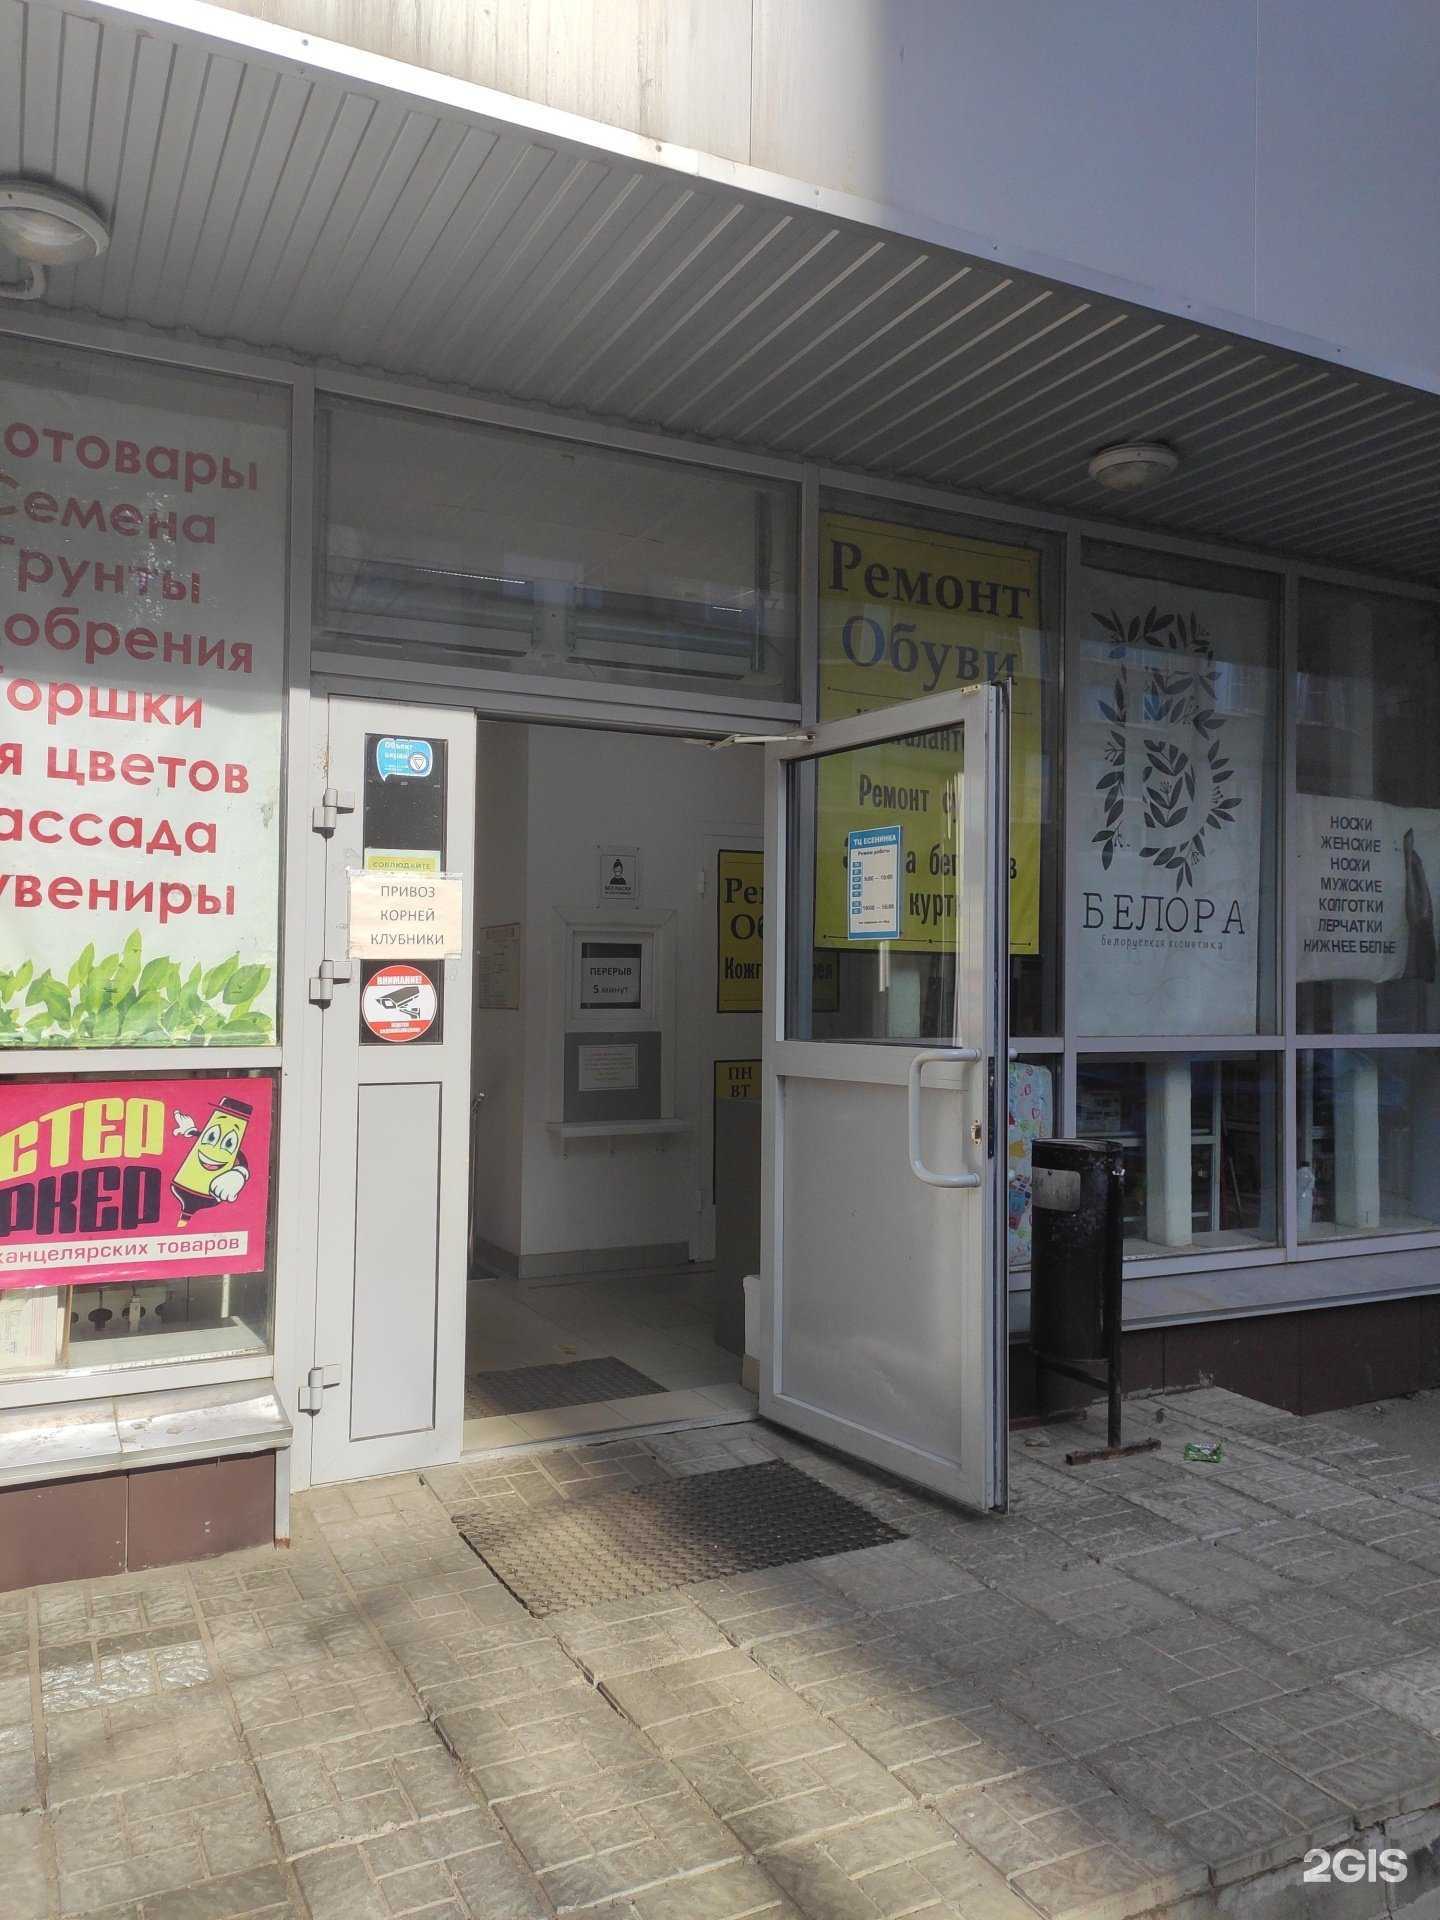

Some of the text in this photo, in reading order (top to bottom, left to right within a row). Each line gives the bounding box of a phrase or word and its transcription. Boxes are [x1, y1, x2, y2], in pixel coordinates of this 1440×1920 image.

[4, 422, 258, 492] отовары
[828, 539, 1030, 619] Ремонт
[0, 607, 254, 674] обрения
[842, 616, 1018, 692] Обуви
[6, 678, 203, 729] оршки
[47, 746, 249, 794] цветов
[859, 773, 930, 813] Ремонт
[1330, 816, 1372, 831] НОСКИ
[0, 808, 217, 856] ассада
[1320, 836, 1381, 852] ЖЕНСКИЕ
[1330, 857, 1370, 872] НОСКИ
[381, 885, 435, 898] ПРИВОЗ
[724, 877, 763, 905] Ре
[1320, 877, 1383, 893] МУЖСКИЕ
[909, 889, 957, 924] курт
[1083, 892, 1245, 935] БЕЛОРА
[1318, 898, 1384, 913] КОЛГОТКИ
[380, 908, 435, 921] КОРНЕЙ
[1318, 918, 1383, 933] ПЕРЧАТКИ
[370, 933, 444, 945] КЛУБНИКИ
[1303, 939, 1357, 953] НИЖНЕЕ
[590, 967, 633, 977] ПЕРЕРЫВ
[593, 984, 600, 994] 5
[728, 1066, 752, 1081] ПН
[731, 1084, 751, 1098] ВТ
[157, 1237, 240, 1255] товаров
